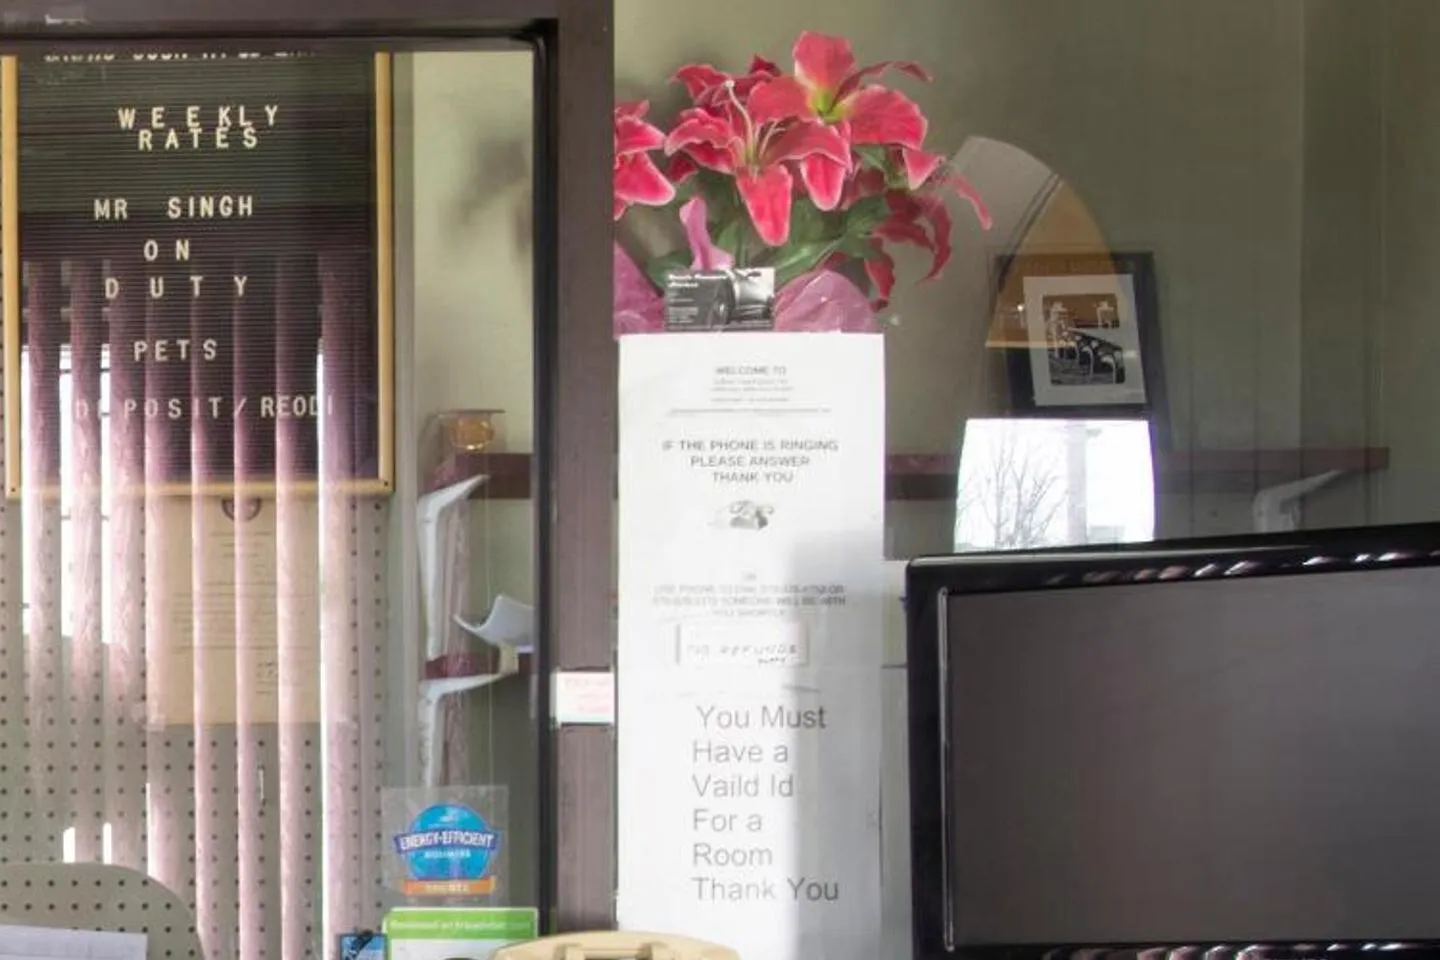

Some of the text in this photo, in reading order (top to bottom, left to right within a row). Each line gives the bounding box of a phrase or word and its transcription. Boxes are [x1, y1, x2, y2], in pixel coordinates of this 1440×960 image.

[117, 104, 279, 130] WEEKLY
[138, 127, 259, 151] RATES
[94, 195, 254, 220] MR SINGH
[143, 239, 191, 262] ON
[104, 275, 248, 300] DUTY
[133, 338, 218, 362] PETS
[679, 440, 704, 451] THE
[710, 440, 757, 451] PHONE
[763, 440, 775, 451] IS
[780, 440, 839, 452] RINGING
[690, 455, 810, 467] PLEASE ANSWER
[713, 471, 794, 483] THANK YOU
[696, 705, 827, 730] You Must
[692, 740, 788, 763] Have a
[692, 773, 795, 798] Vaild Id
[693, 808, 763, 832] For a
[692, 843, 773, 867] Room
[691, 877, 839, 901] Thank You
